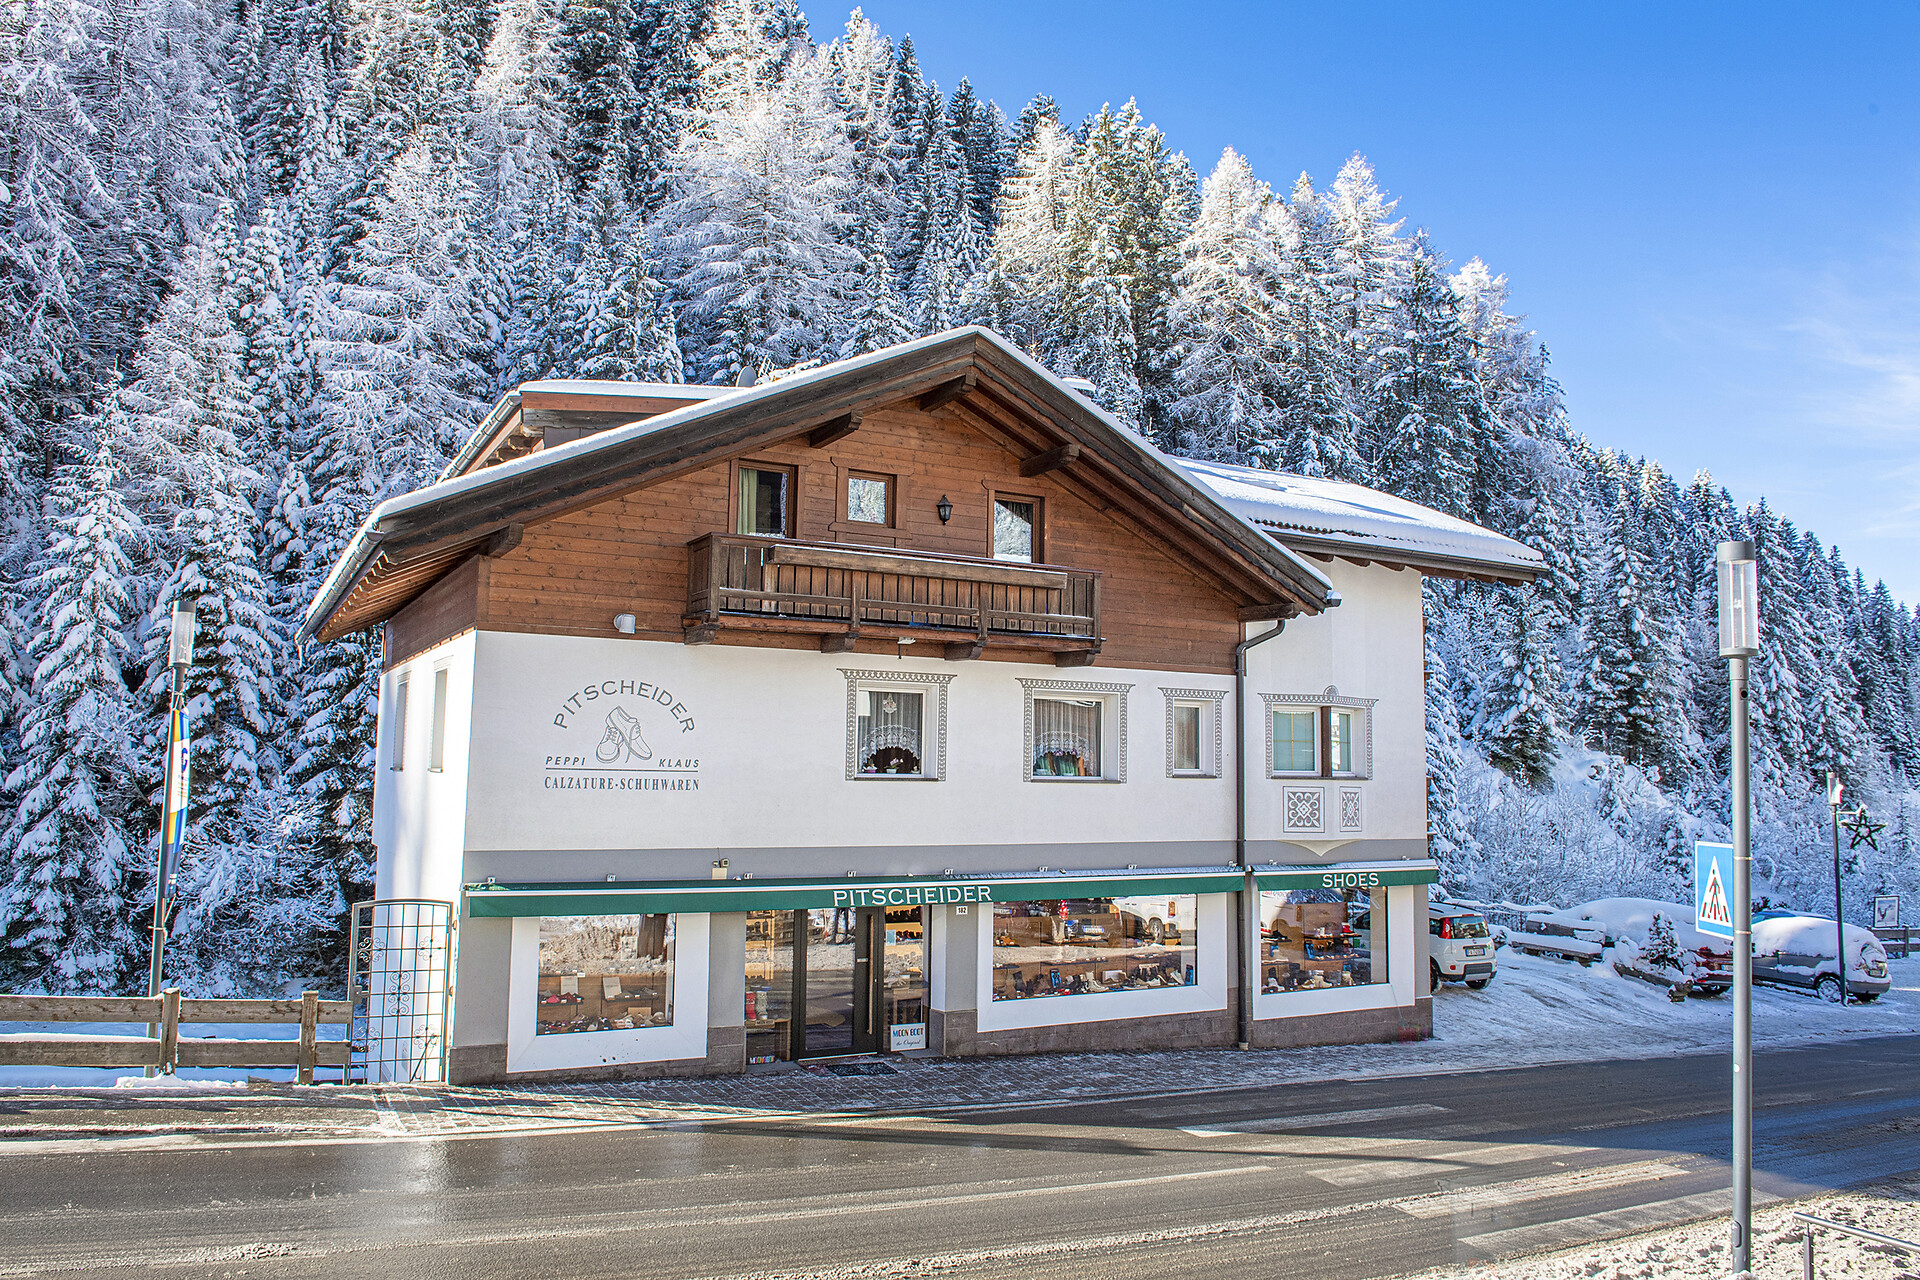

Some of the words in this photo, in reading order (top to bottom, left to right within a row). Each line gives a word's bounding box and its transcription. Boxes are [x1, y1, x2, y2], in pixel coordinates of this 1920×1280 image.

[553, 679, 695, 734] PITSCHEIDER
[545, 756, 586, 766] PEPPI
[658, 758, 700, 768] KLAUS
[1322, 872, 1380, 888] SHOES
[833, 885, 992, 907] PITSCHEIDER
